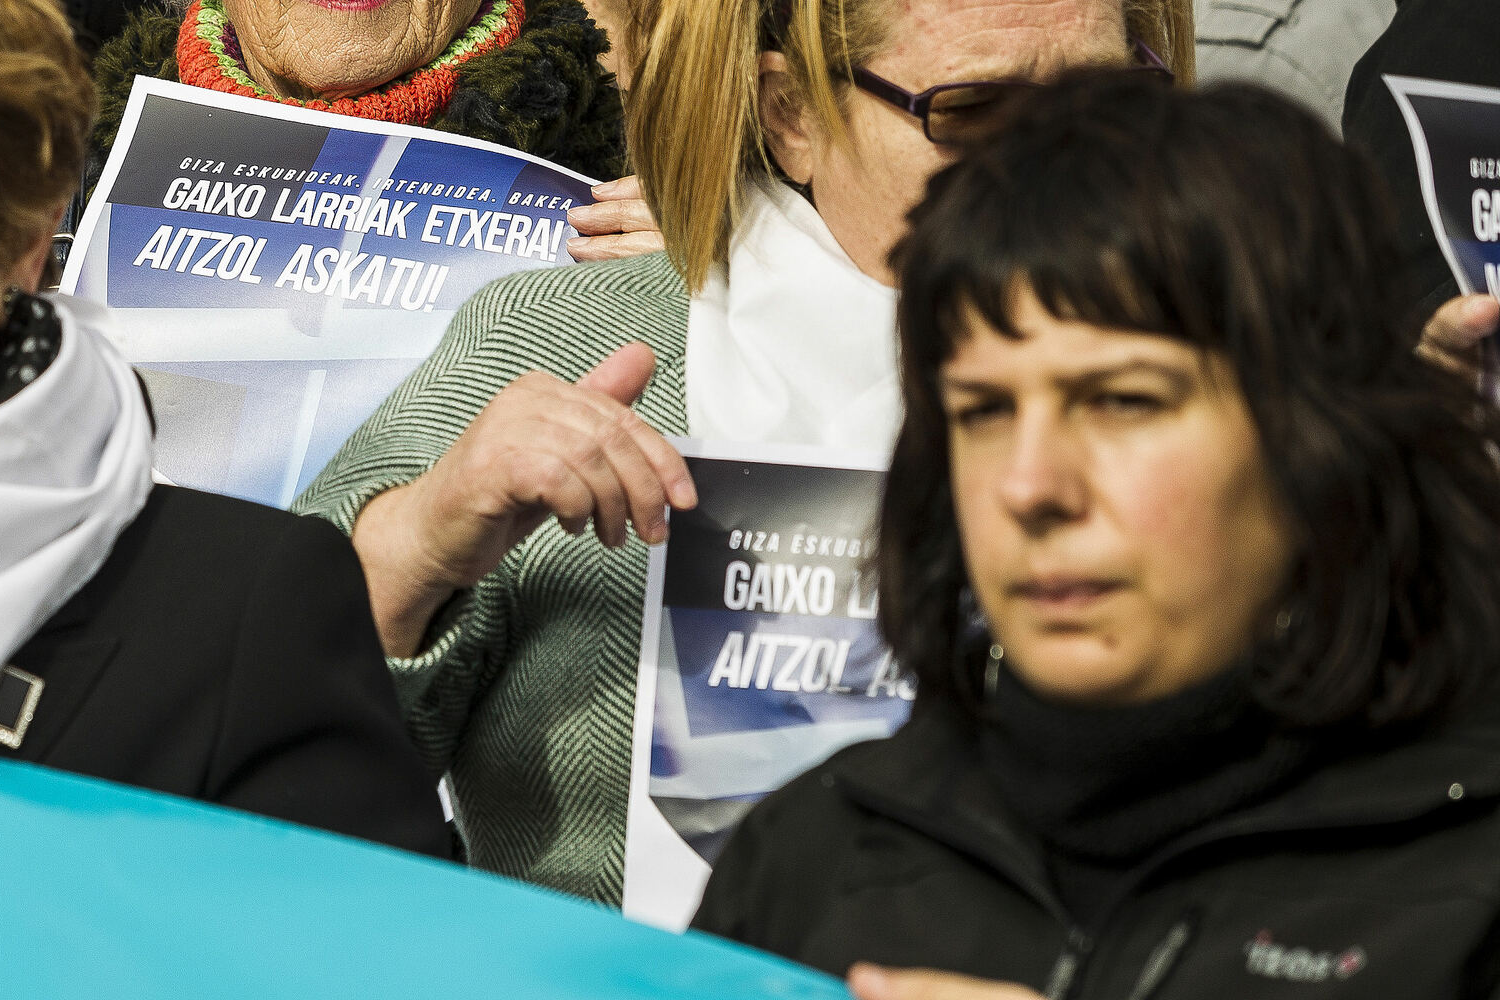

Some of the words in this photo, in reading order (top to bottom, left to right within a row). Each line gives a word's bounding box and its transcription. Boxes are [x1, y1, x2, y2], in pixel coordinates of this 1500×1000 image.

[179, 156, 224, 175] GIZA
[233, 162, 360, 188] ESKUBIDEAK.
[372, 176, 497, 203] IRTENBIDEA.
[508, 190, 574, 212] BAKEA
[163, 176, 260, 219] GAIXO
[269, 189, 419, 240] LARRIAK
[421, 203, 566, 262] ETXERA!
[133, 223, 267, 284] AITZOL
[274, 243, 449, 313] ASKATU!
[729, 529, 780, 553] GIZA
[723, 560, 836, 617] GAIXO
[707, 630, 852, 694] AITZOL
